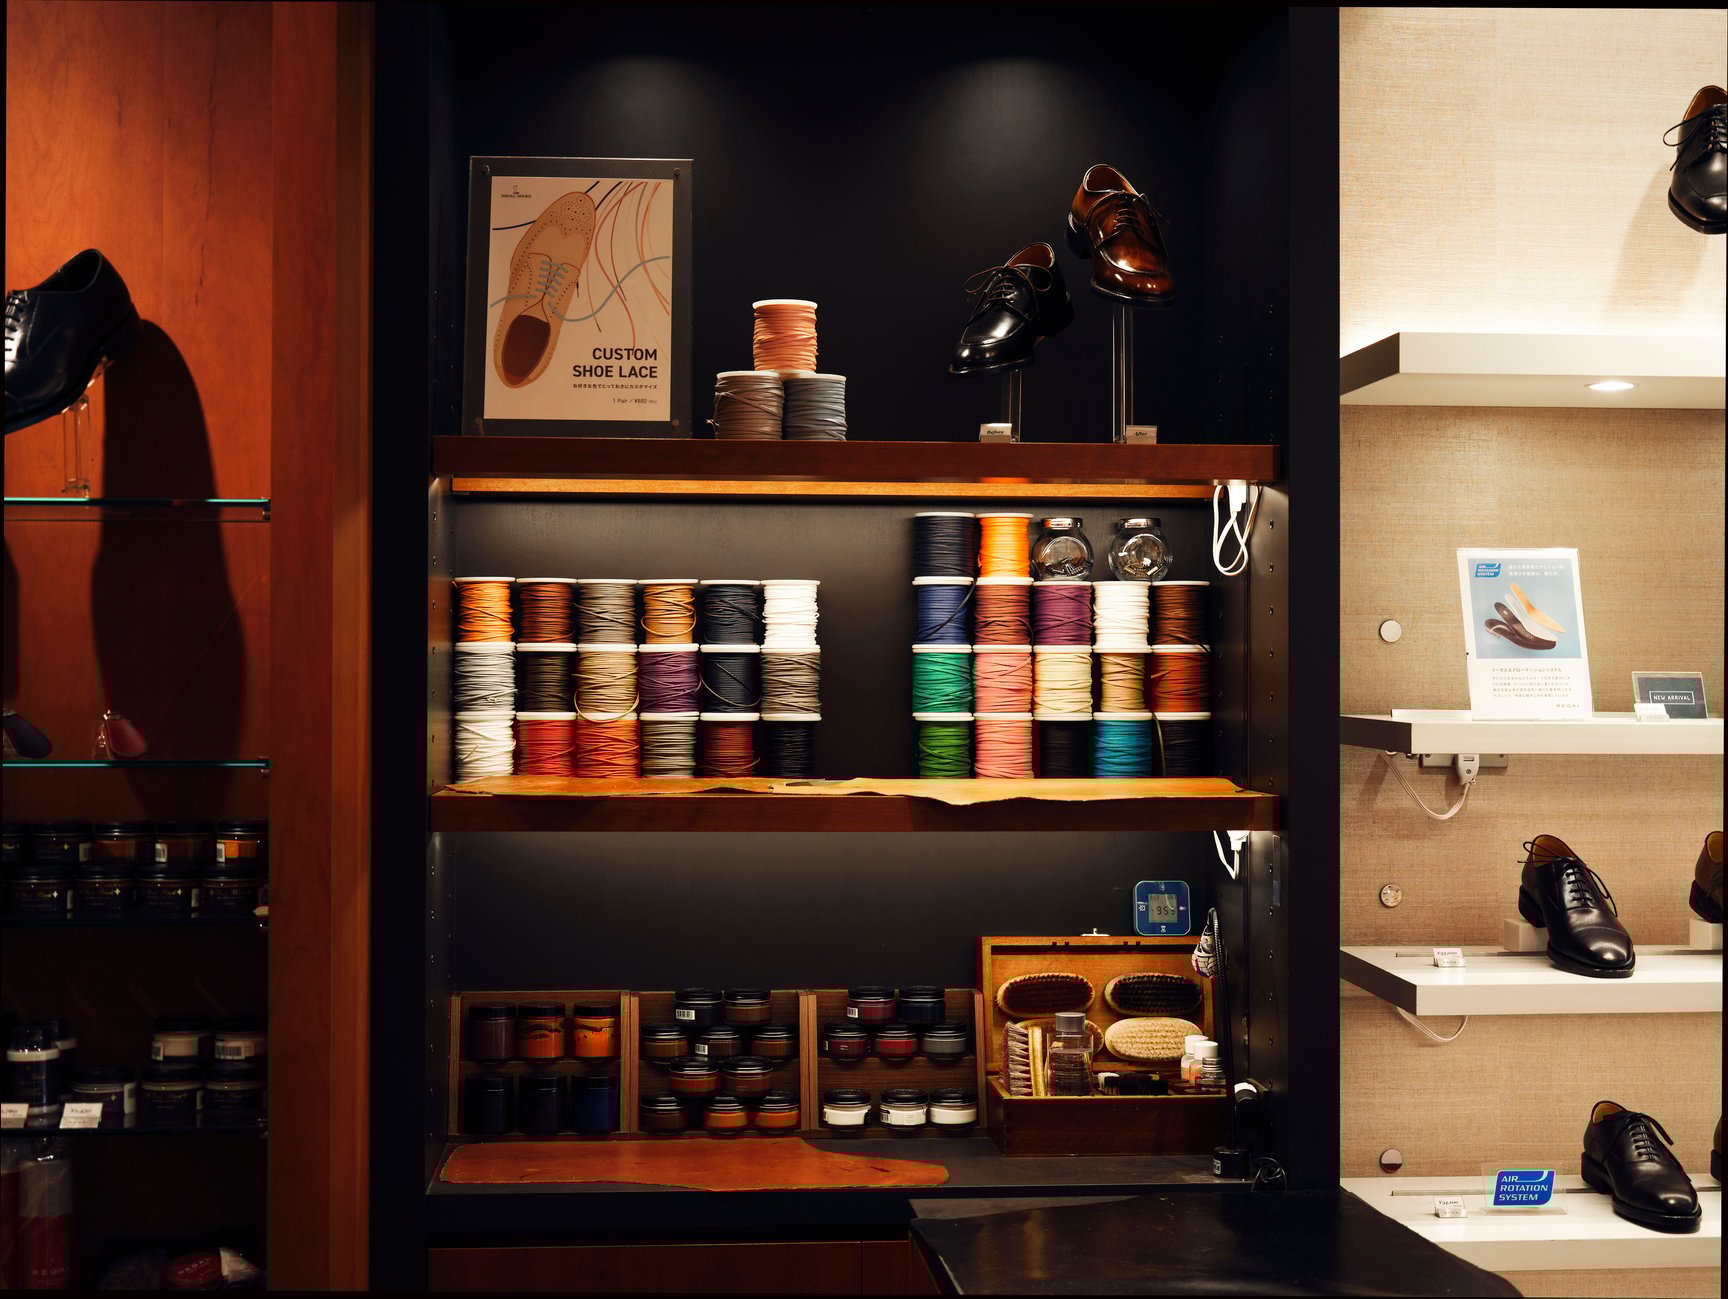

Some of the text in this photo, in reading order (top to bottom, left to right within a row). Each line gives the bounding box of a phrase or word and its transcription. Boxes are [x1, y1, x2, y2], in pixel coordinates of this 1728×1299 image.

[592, 347, 657, 361] CUSTOM
[572, 364, 657, 378] SHOE LACE
[1501, 1175, 1518, 1183] AIR
[1500, 1184, 1549, 1192] ROTATION
